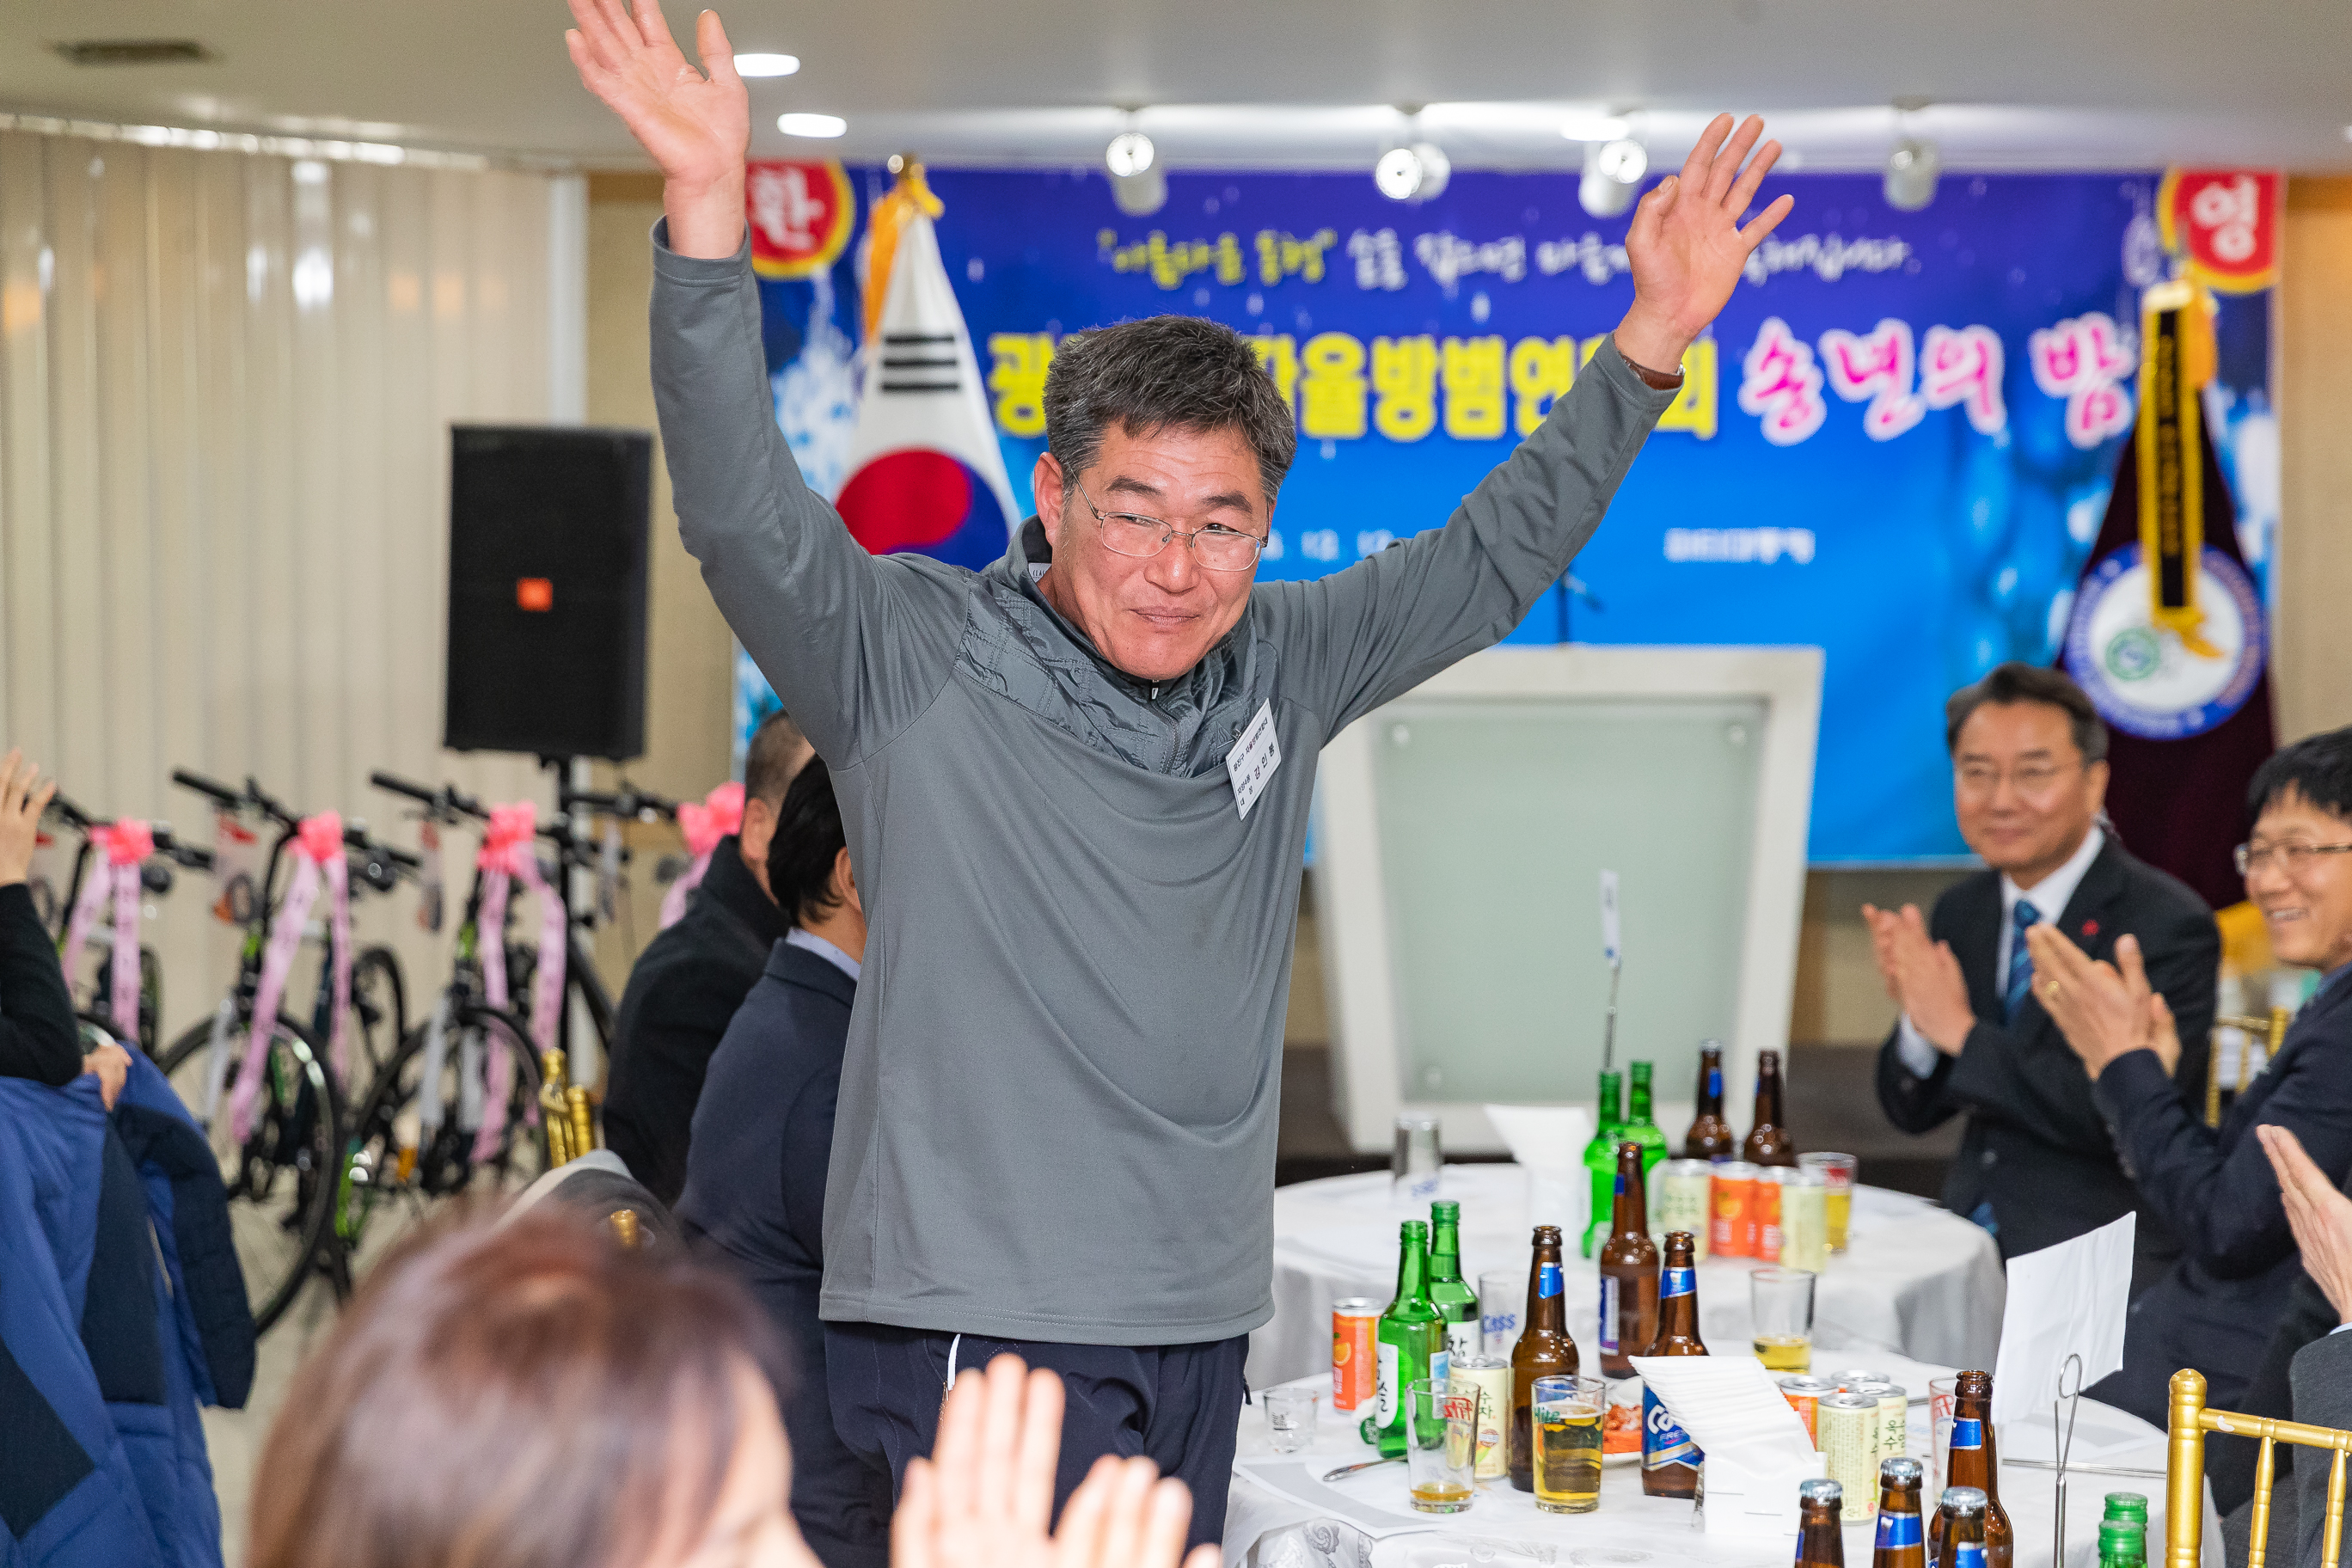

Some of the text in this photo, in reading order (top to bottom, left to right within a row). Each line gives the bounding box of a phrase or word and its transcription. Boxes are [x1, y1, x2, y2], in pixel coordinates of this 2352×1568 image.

[2190, 175, 2260, 263] 영
[1737, 315, 2008, 447] 송년의
[2027, 311, 2138, 449] 밤
